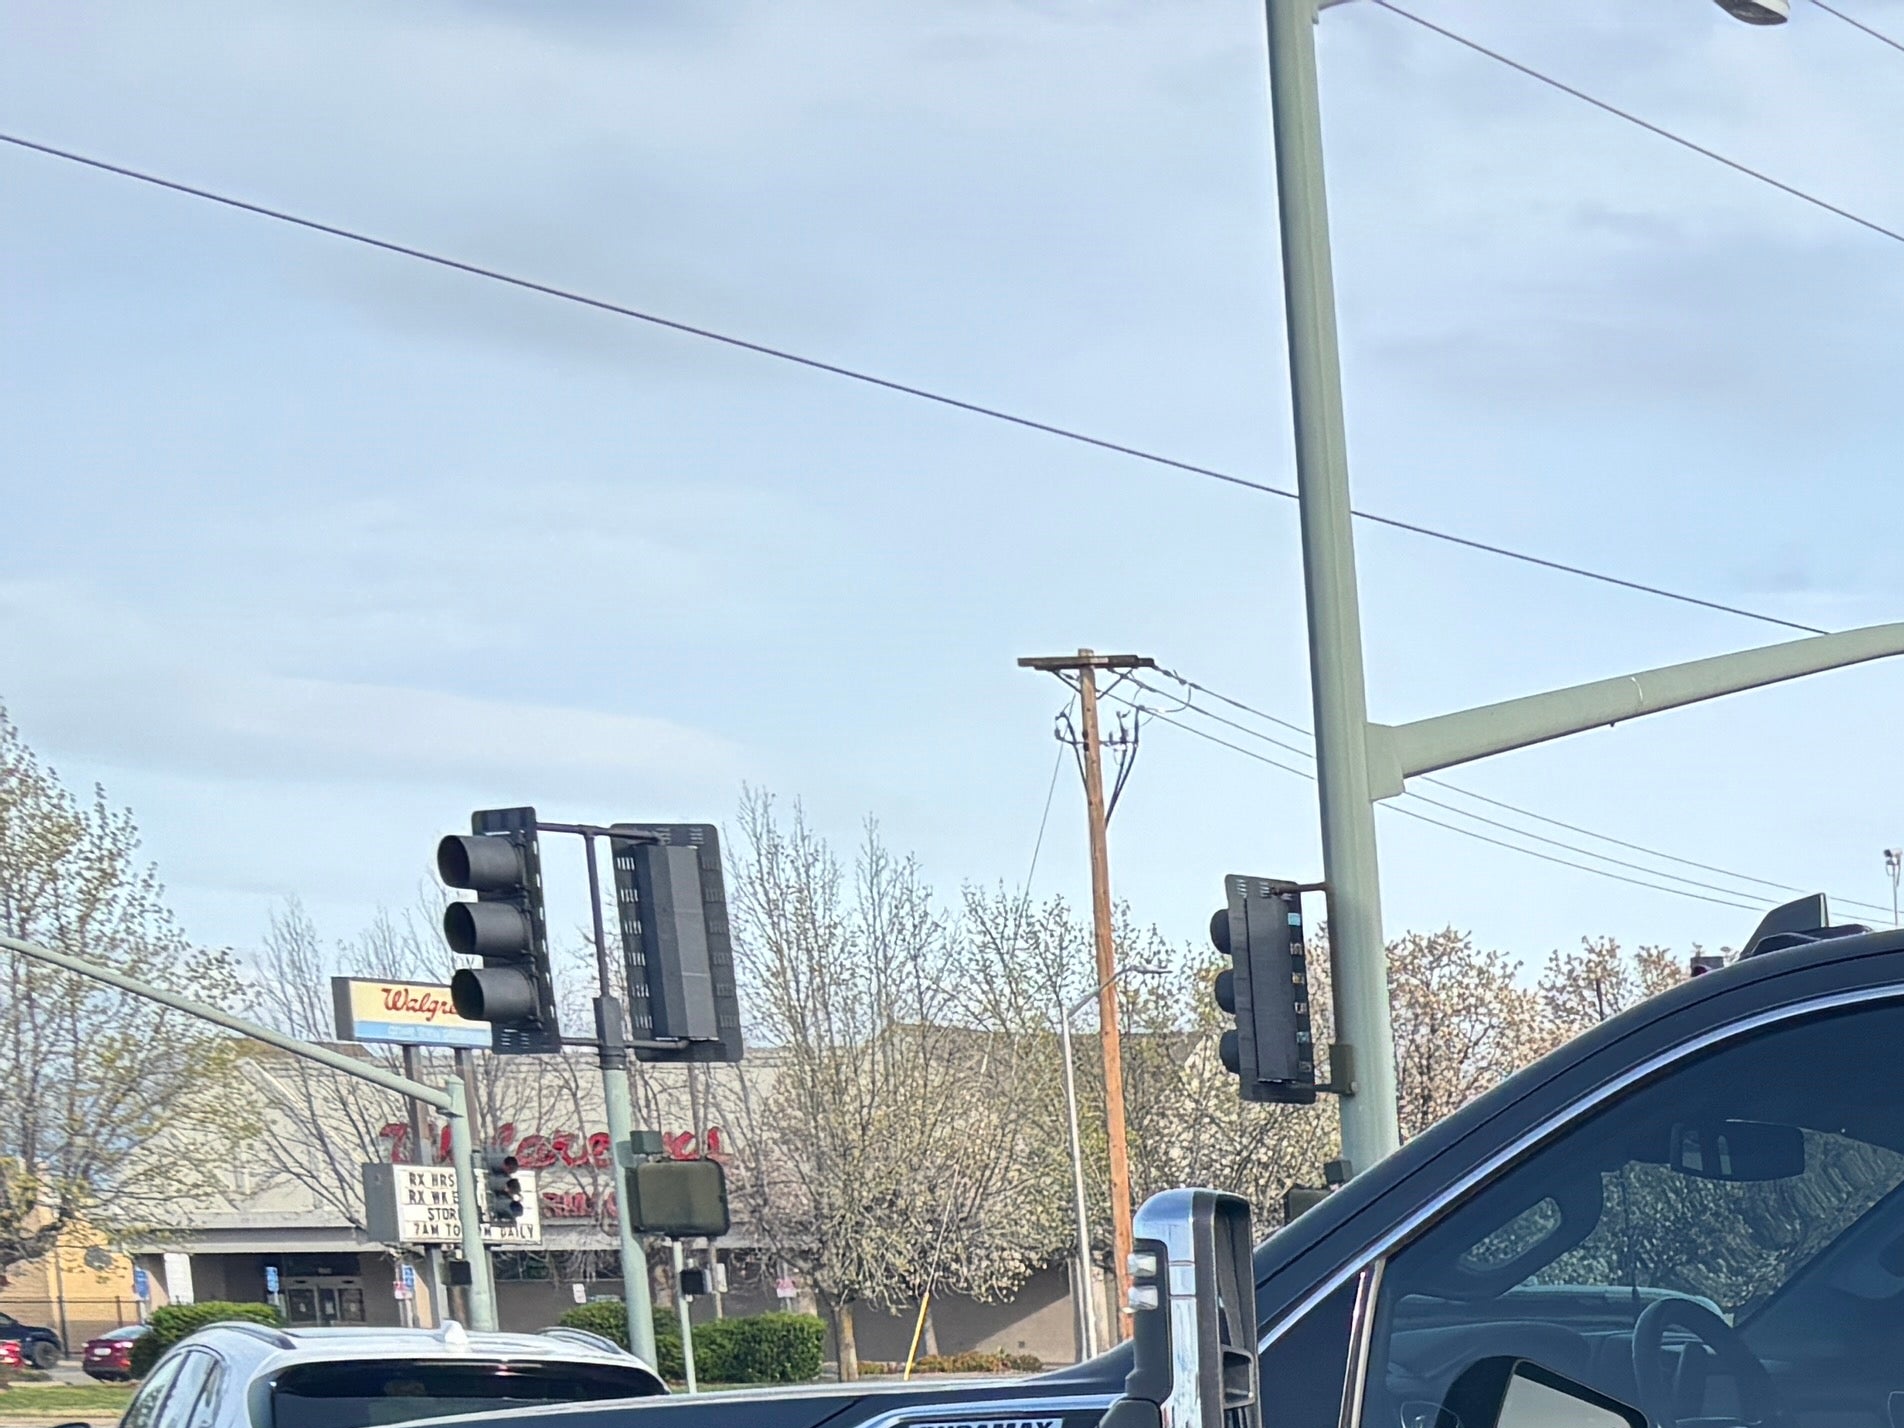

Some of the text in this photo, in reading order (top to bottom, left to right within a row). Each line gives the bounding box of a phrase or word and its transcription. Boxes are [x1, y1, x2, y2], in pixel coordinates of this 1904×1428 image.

[381, 988, 460, 1021] Walgre
[409, 1172, 455, 1187] RX HRS
[409, 1189, 425, 1204] RX
[427, 1207, 458, 1221] STOR
[414, 1224, 439, 1236] 7AM
[446, 1225, 461, 1237] TO
[500, 1224, 533, 1238] DAILY
